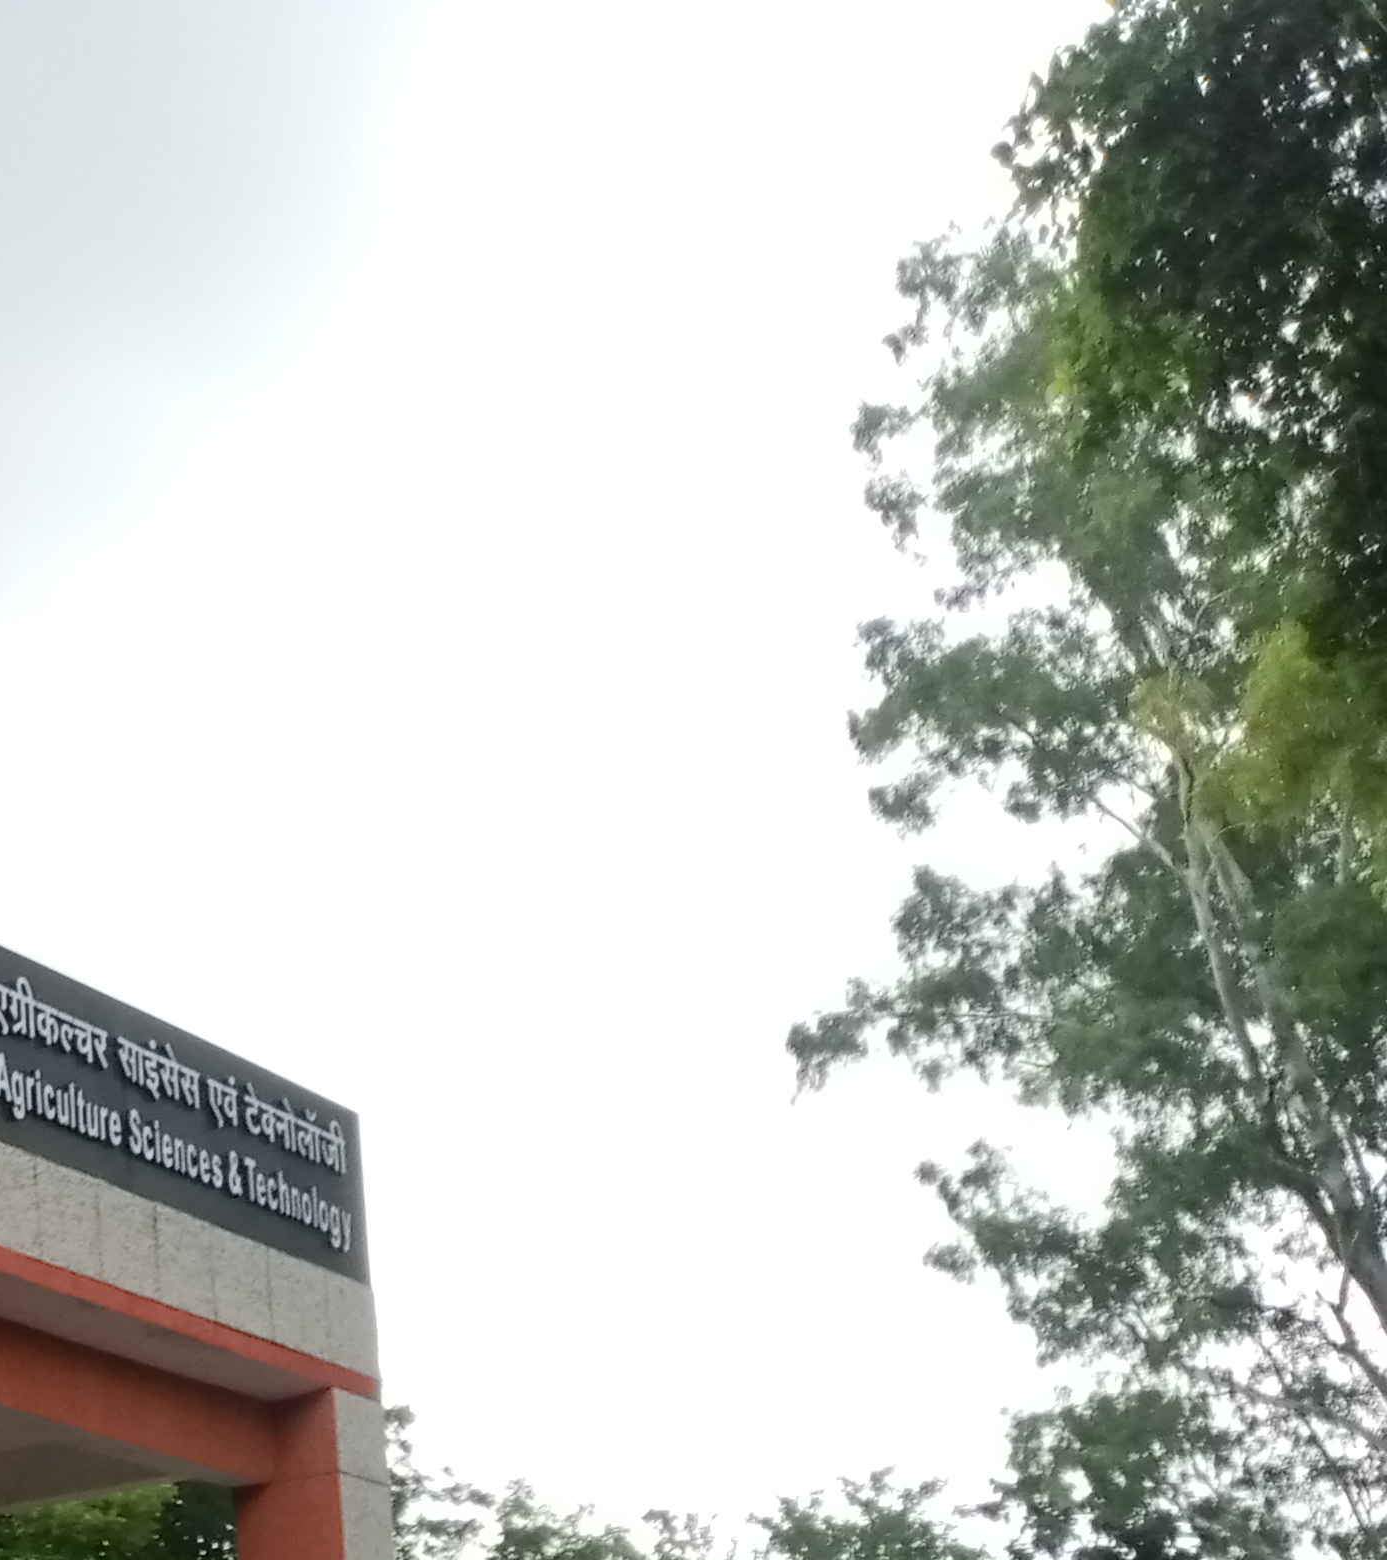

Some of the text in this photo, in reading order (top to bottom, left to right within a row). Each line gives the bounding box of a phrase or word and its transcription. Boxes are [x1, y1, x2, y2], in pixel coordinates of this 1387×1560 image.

[117, 1035, 201, 1110] साइंसेस
[206, 1075, 238, 1129] एवं
[243, 1081, 348, 1175] टेक्नोलॉजी
[129, 1107, 224, 1189] Sciences
[227, 1150, 243, 1197] &
[244, 1156, 353, 1253] Technology
